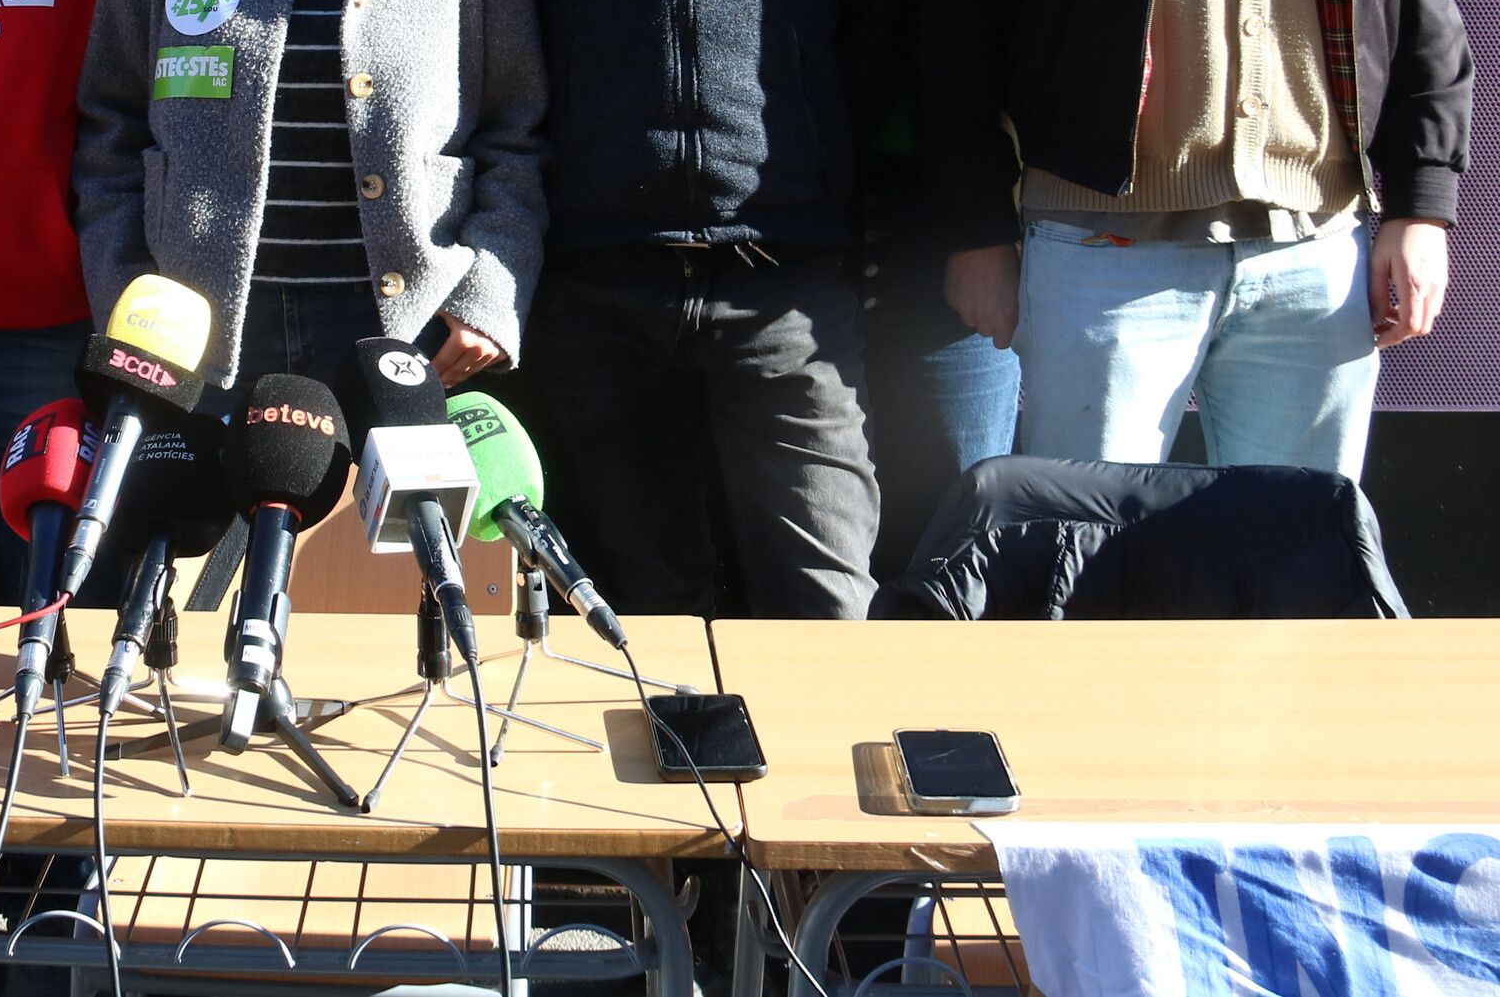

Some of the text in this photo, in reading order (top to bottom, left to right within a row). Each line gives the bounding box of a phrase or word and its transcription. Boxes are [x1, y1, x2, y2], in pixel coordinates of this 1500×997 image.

[212, 78, 228, 87] IAC
[462, 421, 493, 439] ERO
[5, 423, 32, 470] RAC
[141, 442, 186, 451] ATALANA
[146, 450, 195, 461] NOTÍCIES
